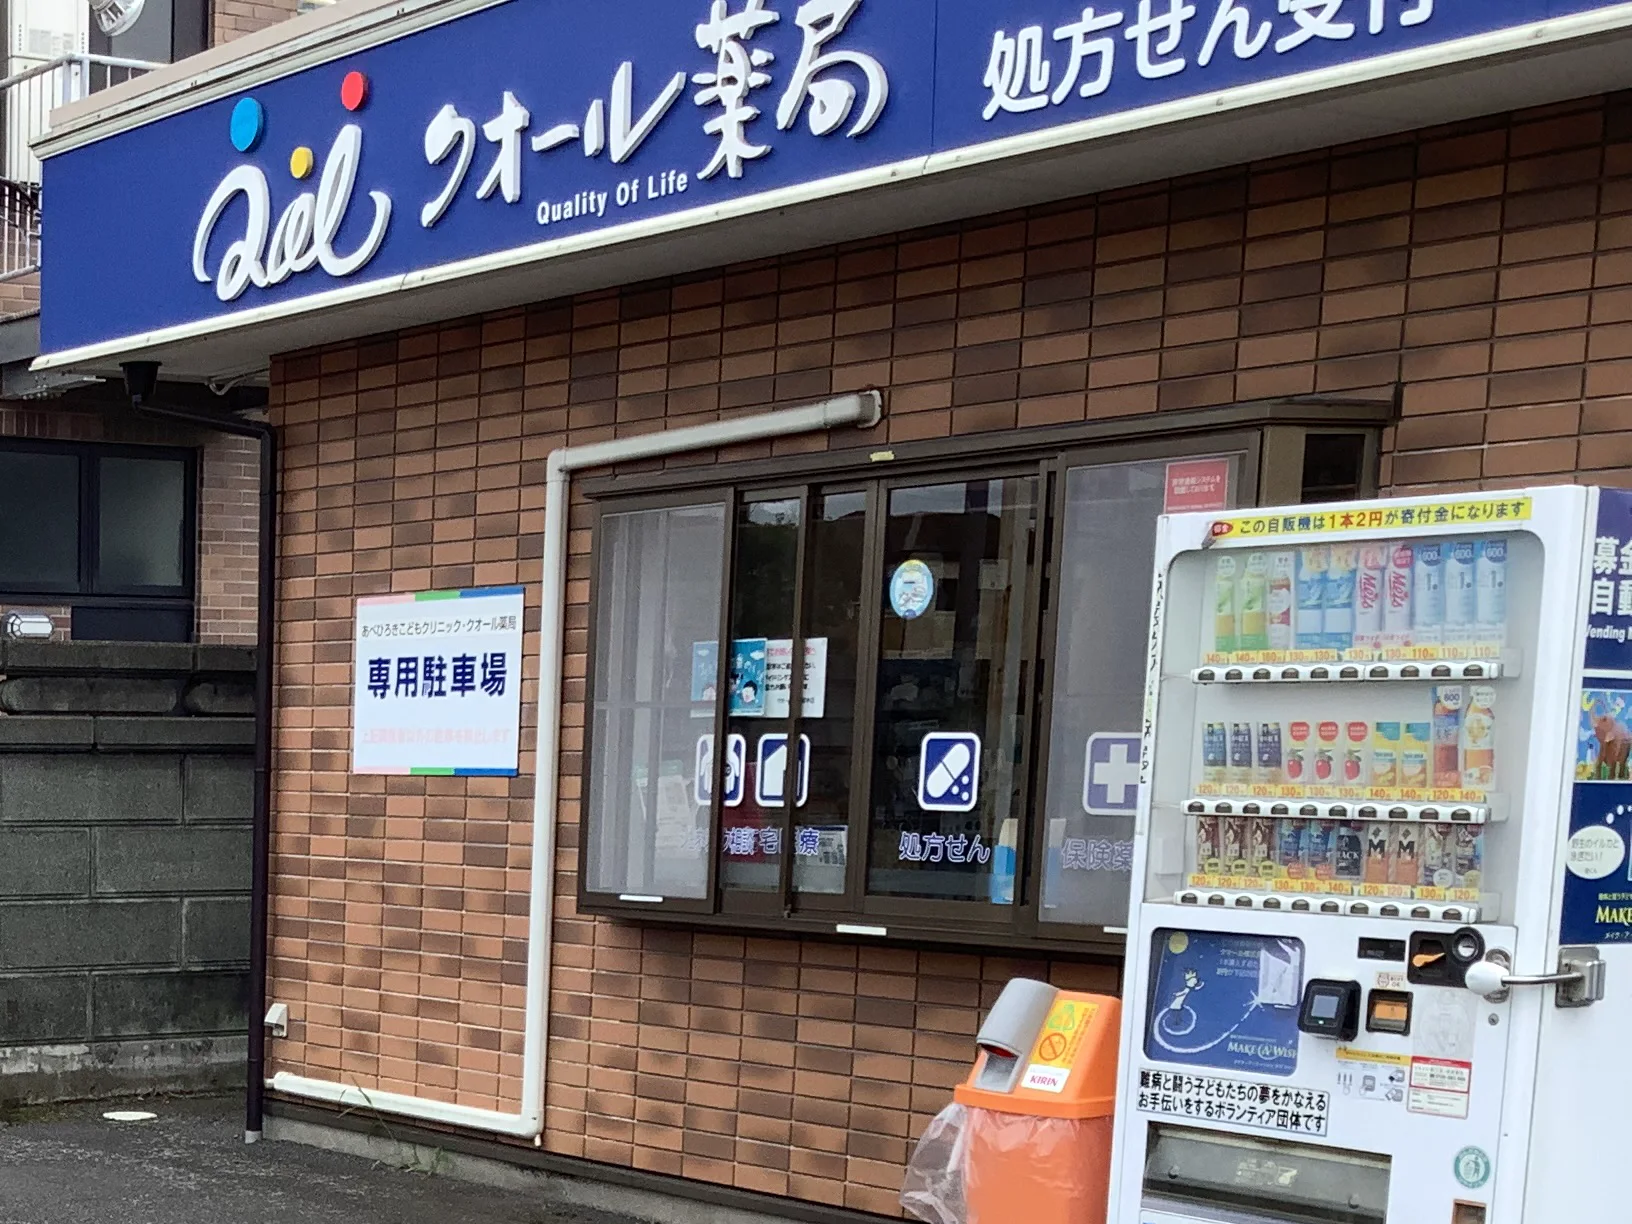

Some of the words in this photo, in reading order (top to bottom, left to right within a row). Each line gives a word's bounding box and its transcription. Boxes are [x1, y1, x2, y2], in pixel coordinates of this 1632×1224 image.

[421, 0, 888, 228] クオール薬局
[537, 188, 607, 225] Quality
[615, 182, 639, 207] Of
[648, 170, 689, 202] Life
[367, 652, 508, 700] 専用駐車場
[898, 830, 991, 865] 処方せん
[1029, 1075, 1059, 1087] KIRIN
[1140, 1070, 1327, 1111] 難病と闘う子どもたちの夢をかなえる
[1138, 1091, 1326, 1132] お手伝いをするボランティア団体です
